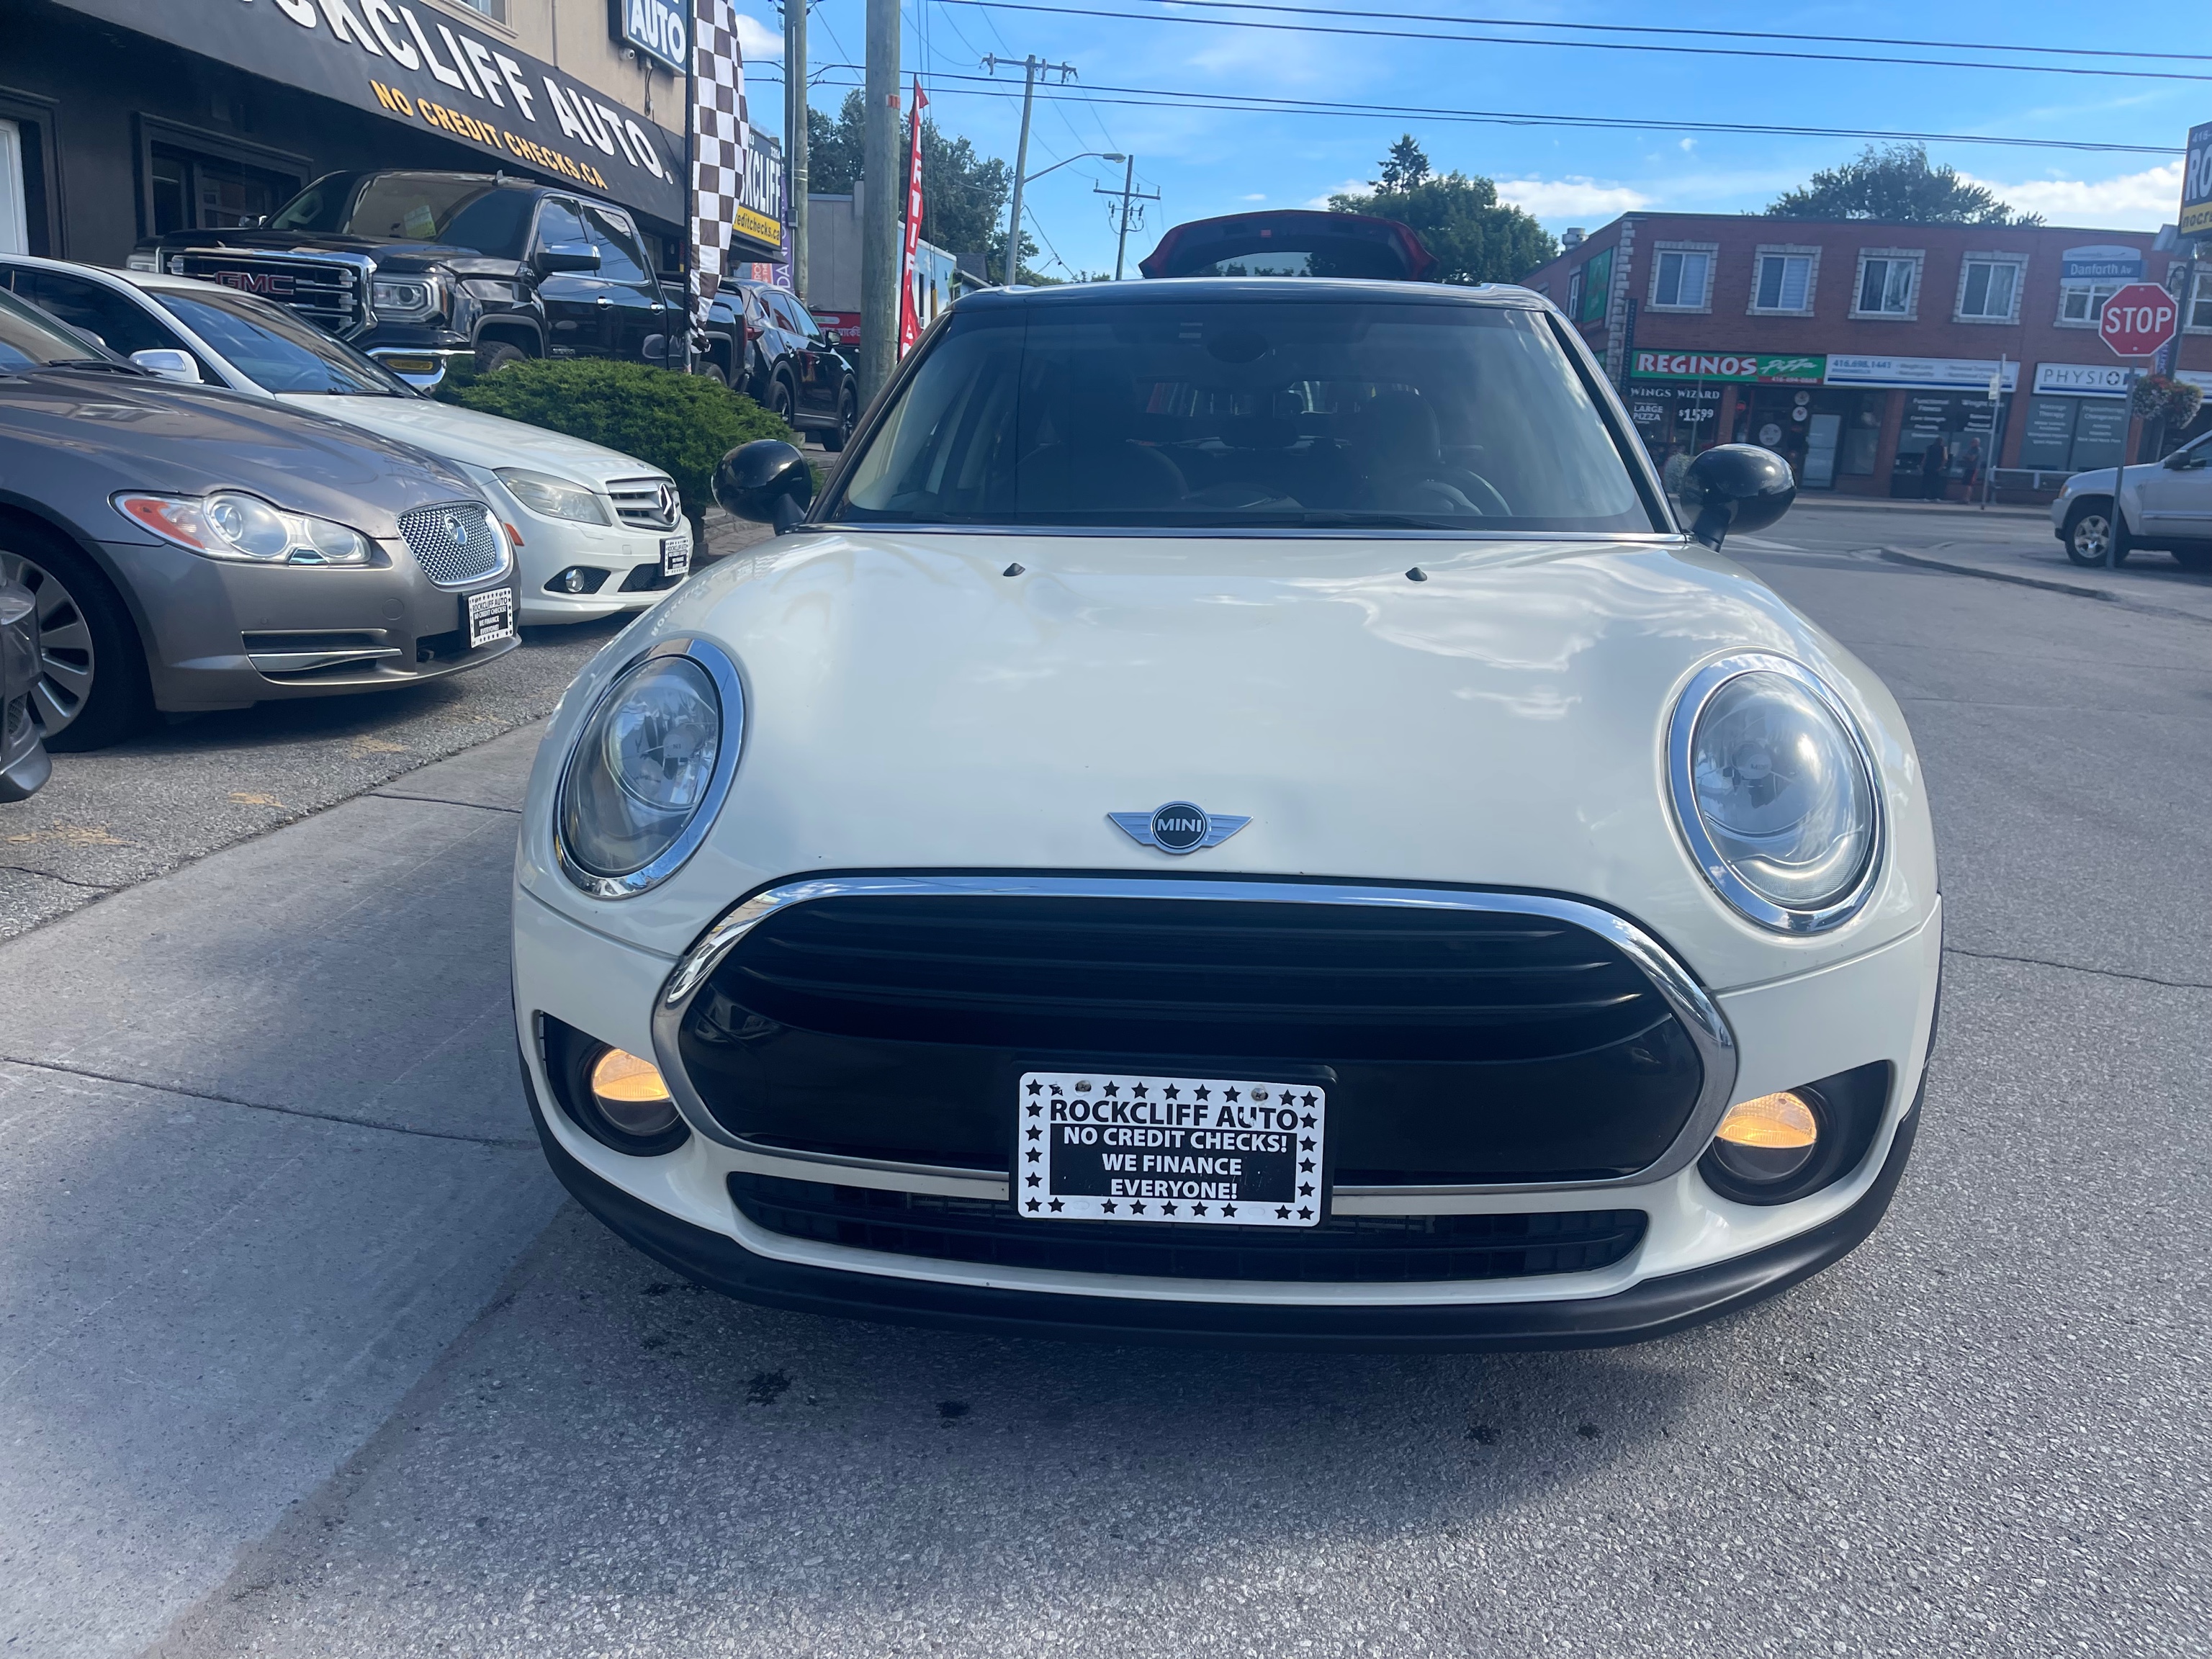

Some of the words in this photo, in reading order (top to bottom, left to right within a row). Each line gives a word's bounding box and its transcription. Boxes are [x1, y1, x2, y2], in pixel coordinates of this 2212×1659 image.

[631, 0, 686, 63] AUTO
[370, 79, 414, 117] NO
[416, 97, 503, 149] CREDIT
[503, 130, 608, 190] CHECKS.CA
[741, 148, 781, 218] KCLIFF
[2070, 264, 2118, 275] Danforth
[215, 270, 294, 295] GMC
[2105, 307, 2172, 333] STOP
[1638, 353, 1757, 375] REGINOS
[1630, 388, 1671, 397] WINGS
[1677, 390, 1719, 400] WIZARD
[495, 597, 508, 606] AUTO
[1157, 818, 1202, 832] MINI
[1050, 1100, 1208, 1126] ROCKCLIFF
[1216, 1106, 1298, 1130] AUTO
[1064, 1126, 1098, 1145] NO
[1103, 1128, 1185, 1148] CREDIT
[1190, 1131, 1287, 1153] CHECKS!
[1102, 1154, 1137, 1172] WE
[1143, 1154, 1242, 1175] FINANCE
[1111, 1179, 1238, 1200] EVERYONE!
